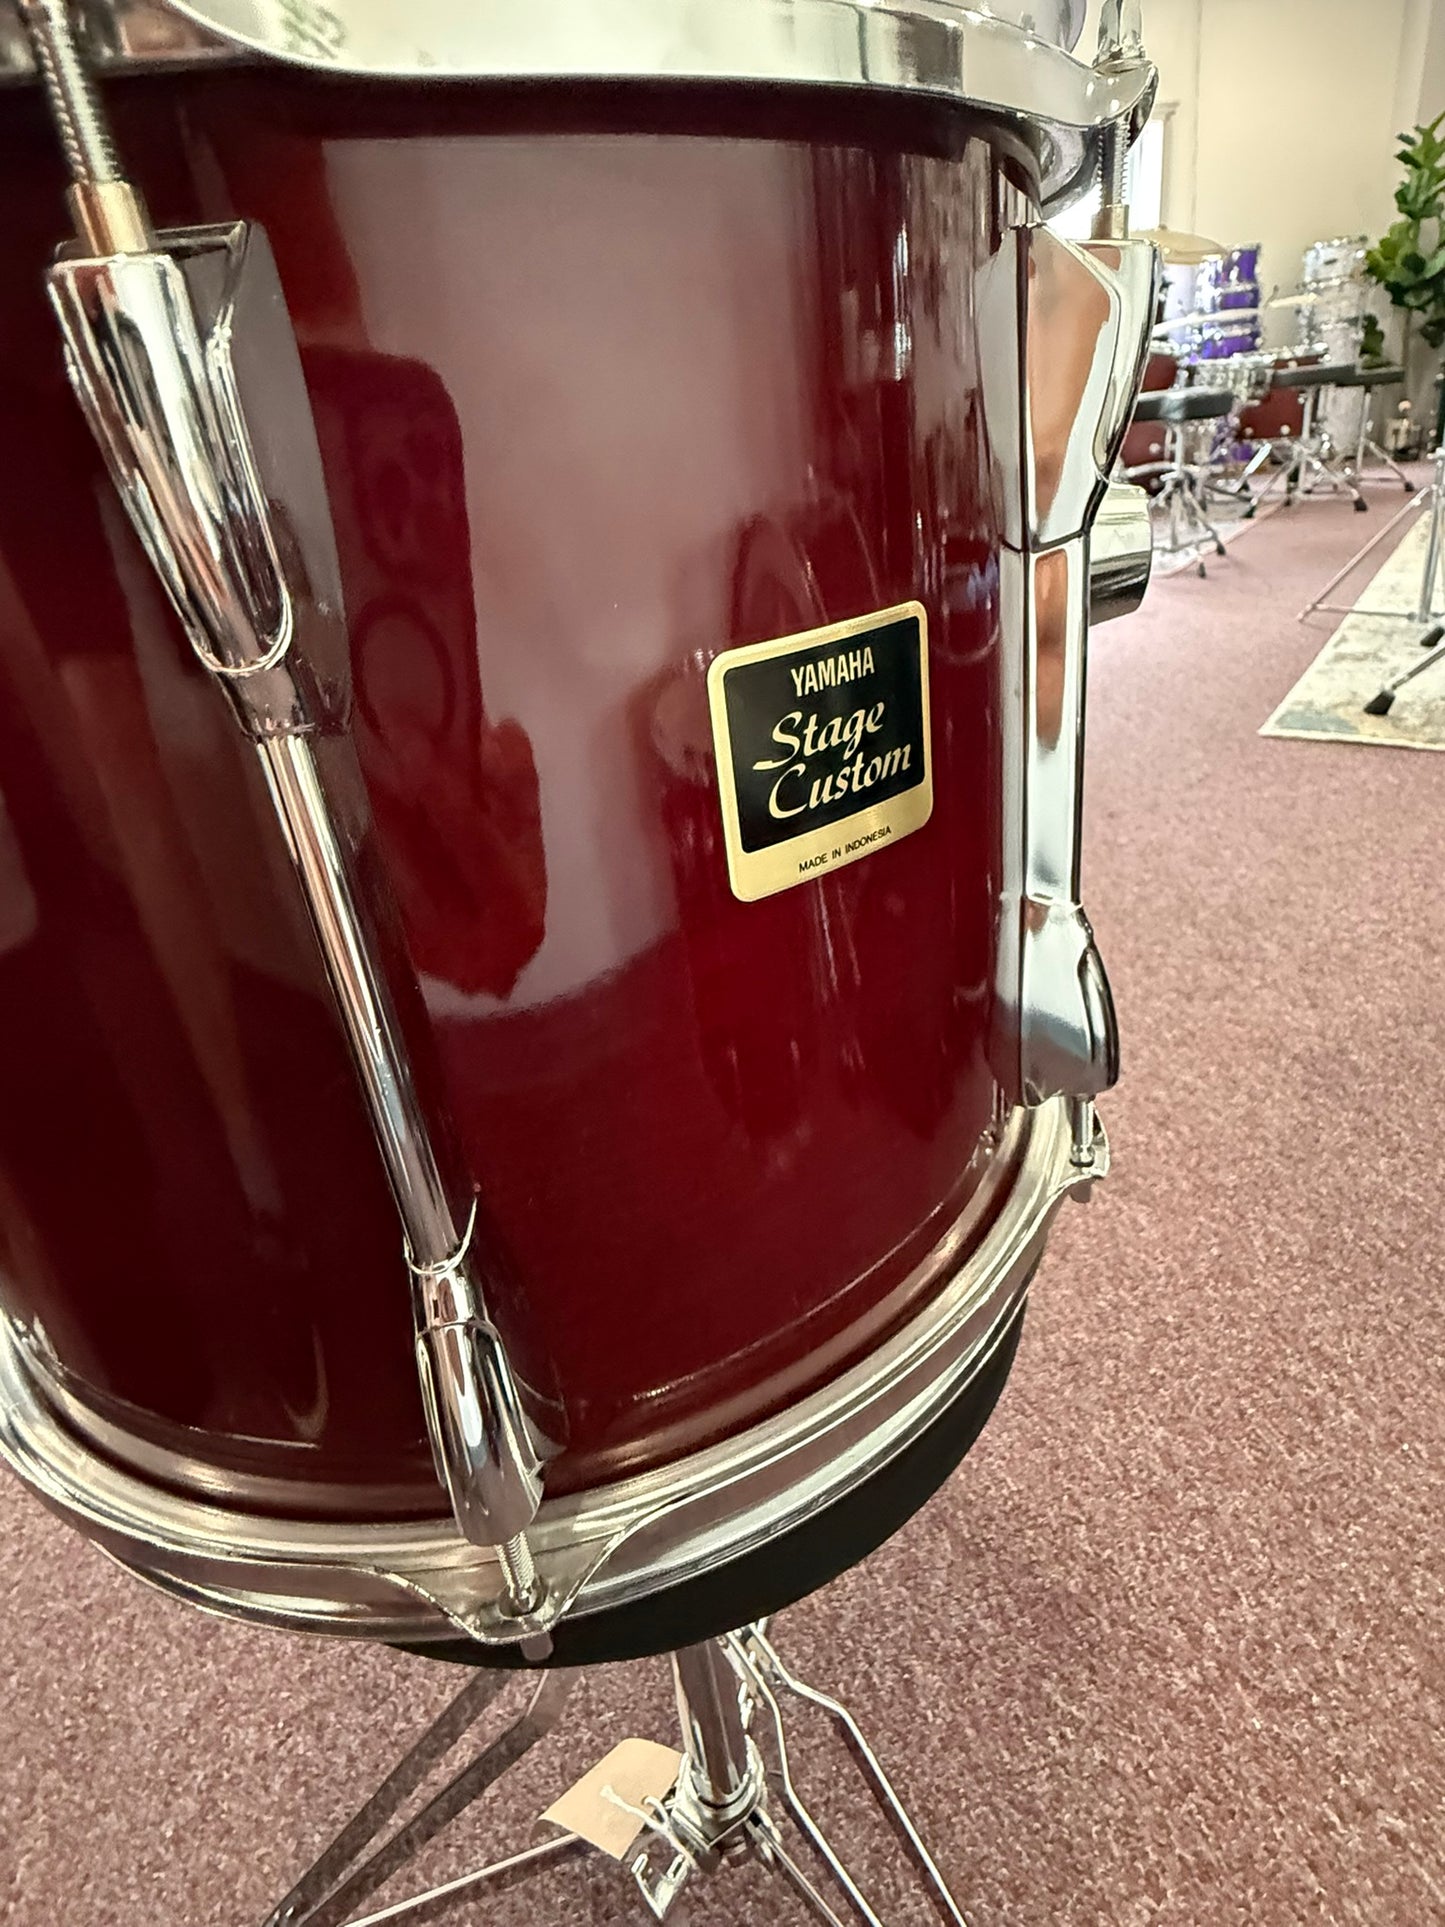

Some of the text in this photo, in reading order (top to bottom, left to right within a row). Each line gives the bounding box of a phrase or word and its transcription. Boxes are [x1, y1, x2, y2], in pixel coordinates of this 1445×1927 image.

[791, 646, 875, 697] YAMAHA
[752, 701, 885, 771] Stage
[768, 743, 912, 819] Custom
[799, 825, 892, 873] MADE IN INDONESIA
